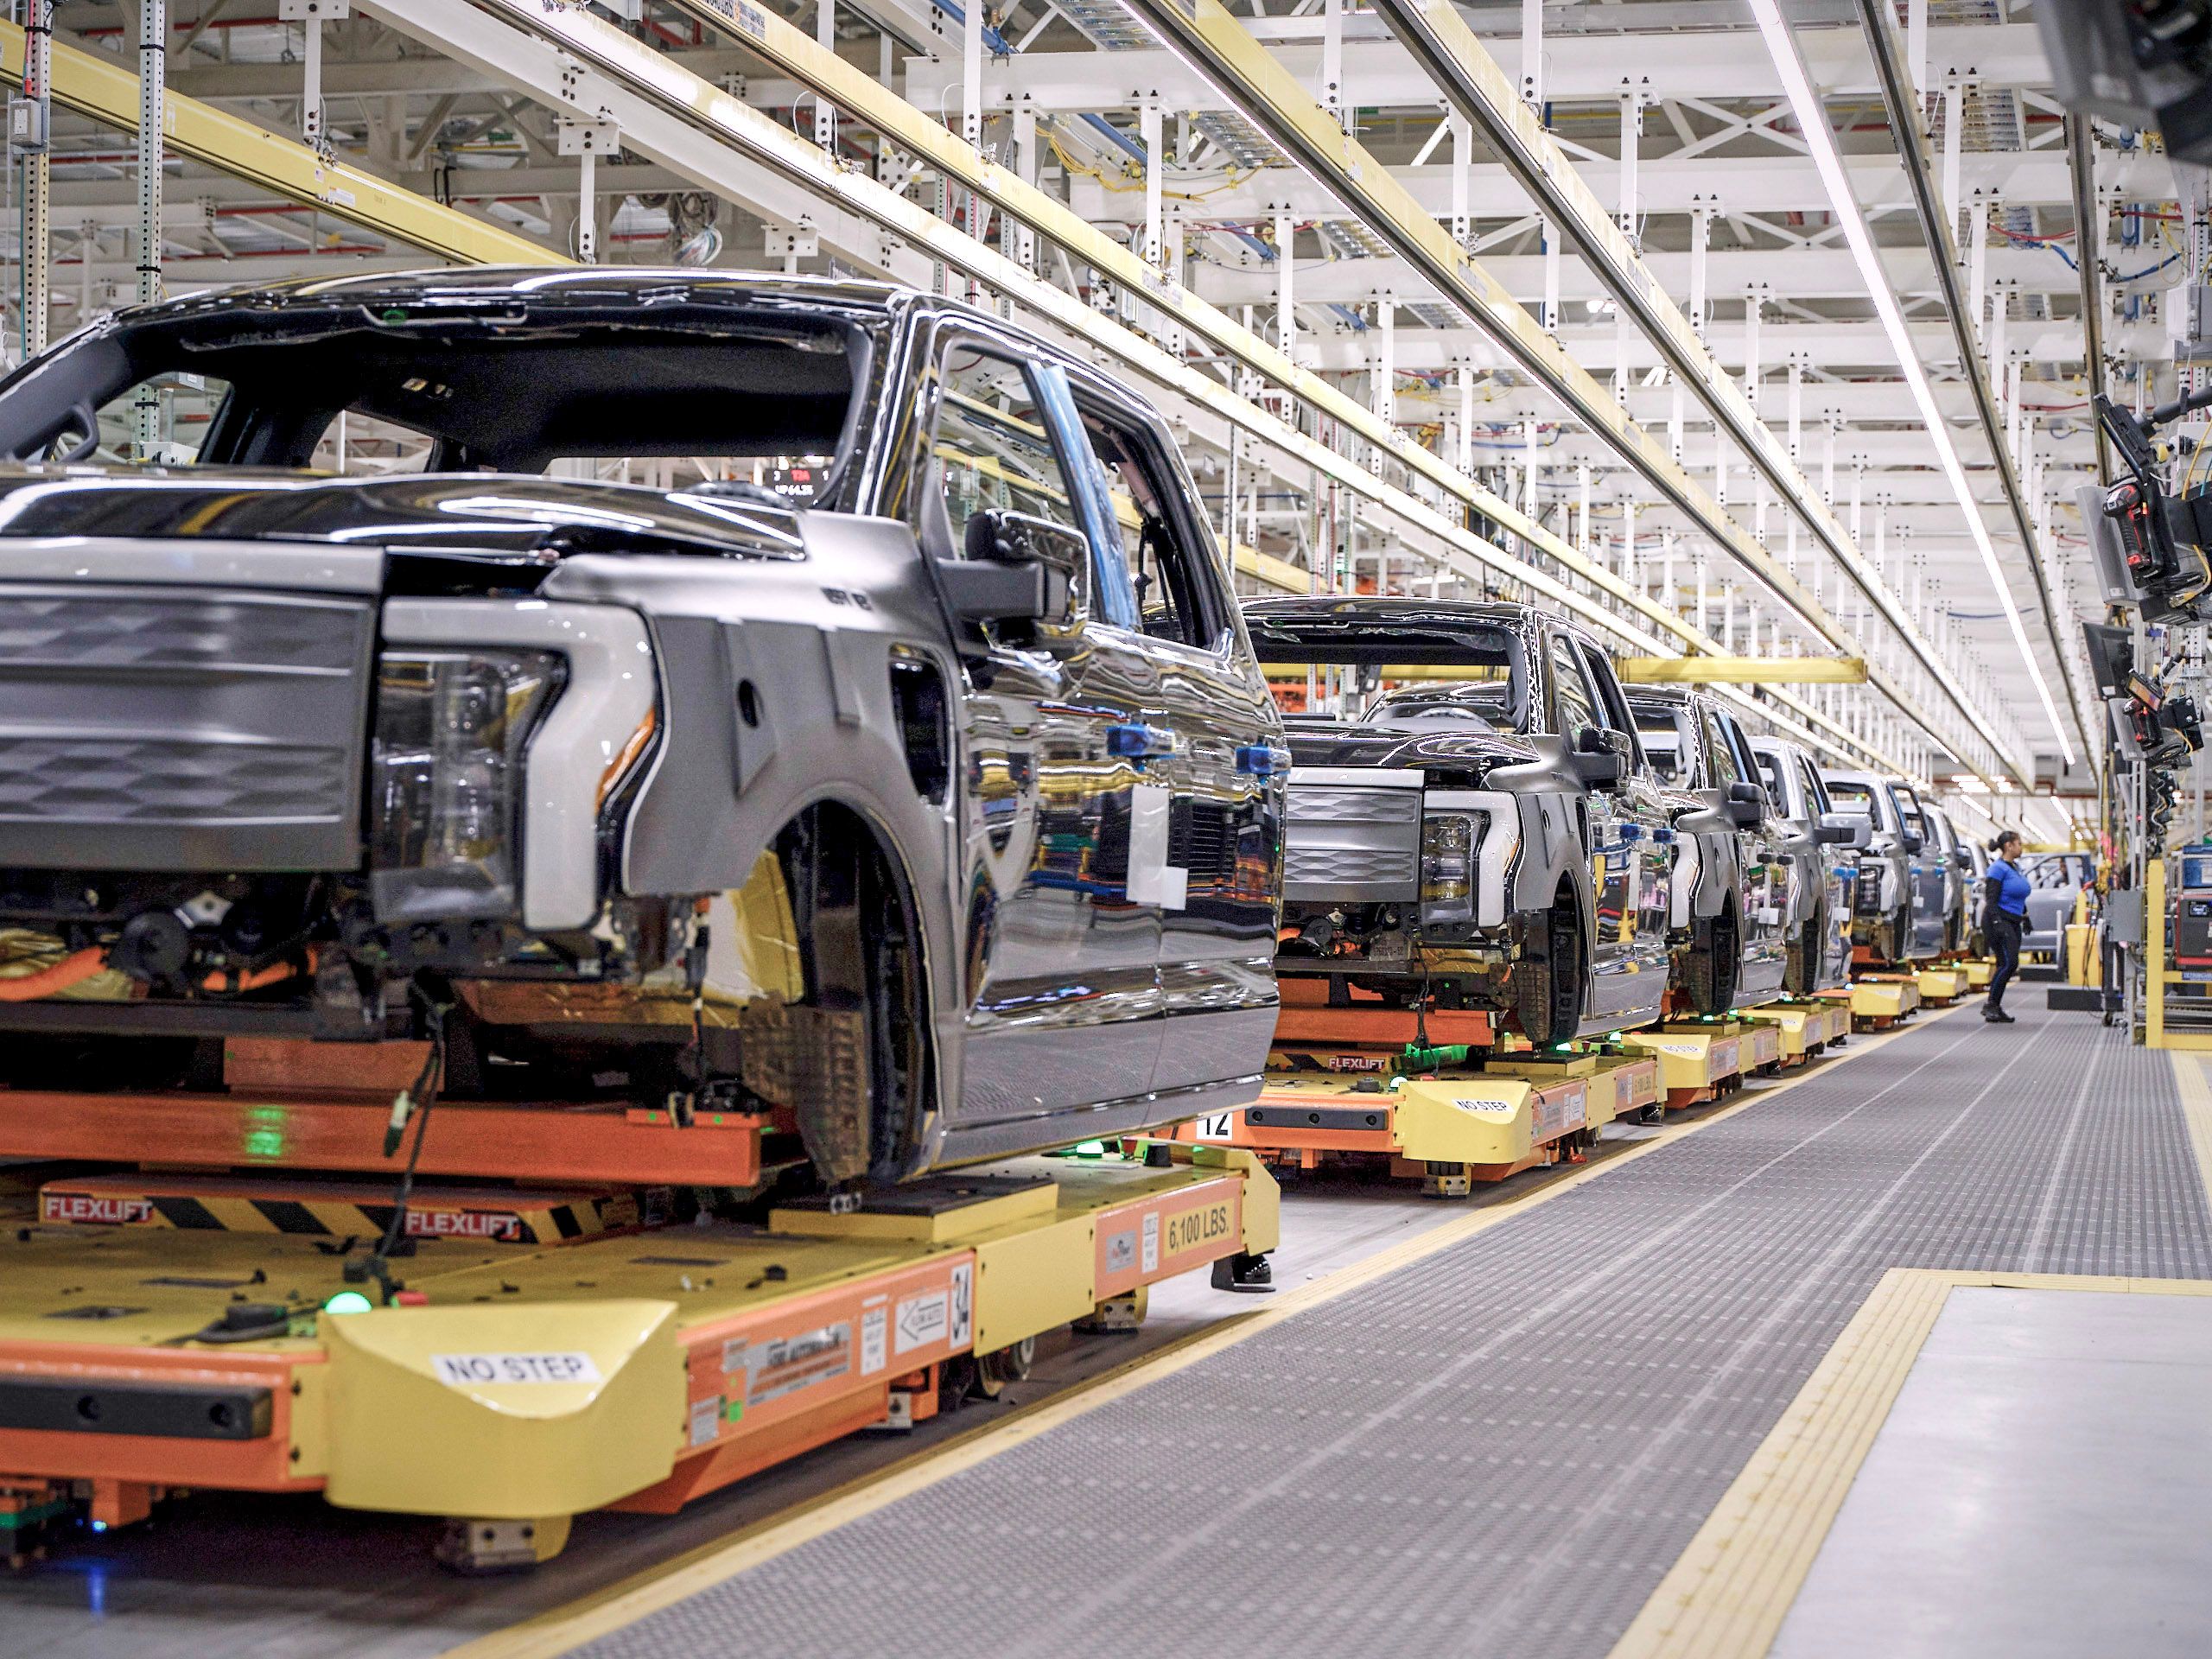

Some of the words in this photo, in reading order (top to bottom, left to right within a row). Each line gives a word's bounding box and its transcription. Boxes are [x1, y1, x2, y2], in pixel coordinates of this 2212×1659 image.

[1329, 1057, 1385, 1070] FLEXLIFT
[1456, 1100, 1478, 1110] NO
[1477, 1100, 1507, 1111] STEP
[45, 1196, 154, 1221] FLEXLIFT
[404, 1211, 519, 1237] FLEXLIFT
[1168, 1213, 1200, 1252] 6,100
[1203, 1205, 1230, 1238] LBS.
[443, 1357, 496, 1381] NO
[501, 1355, 582, 1380] STEP
